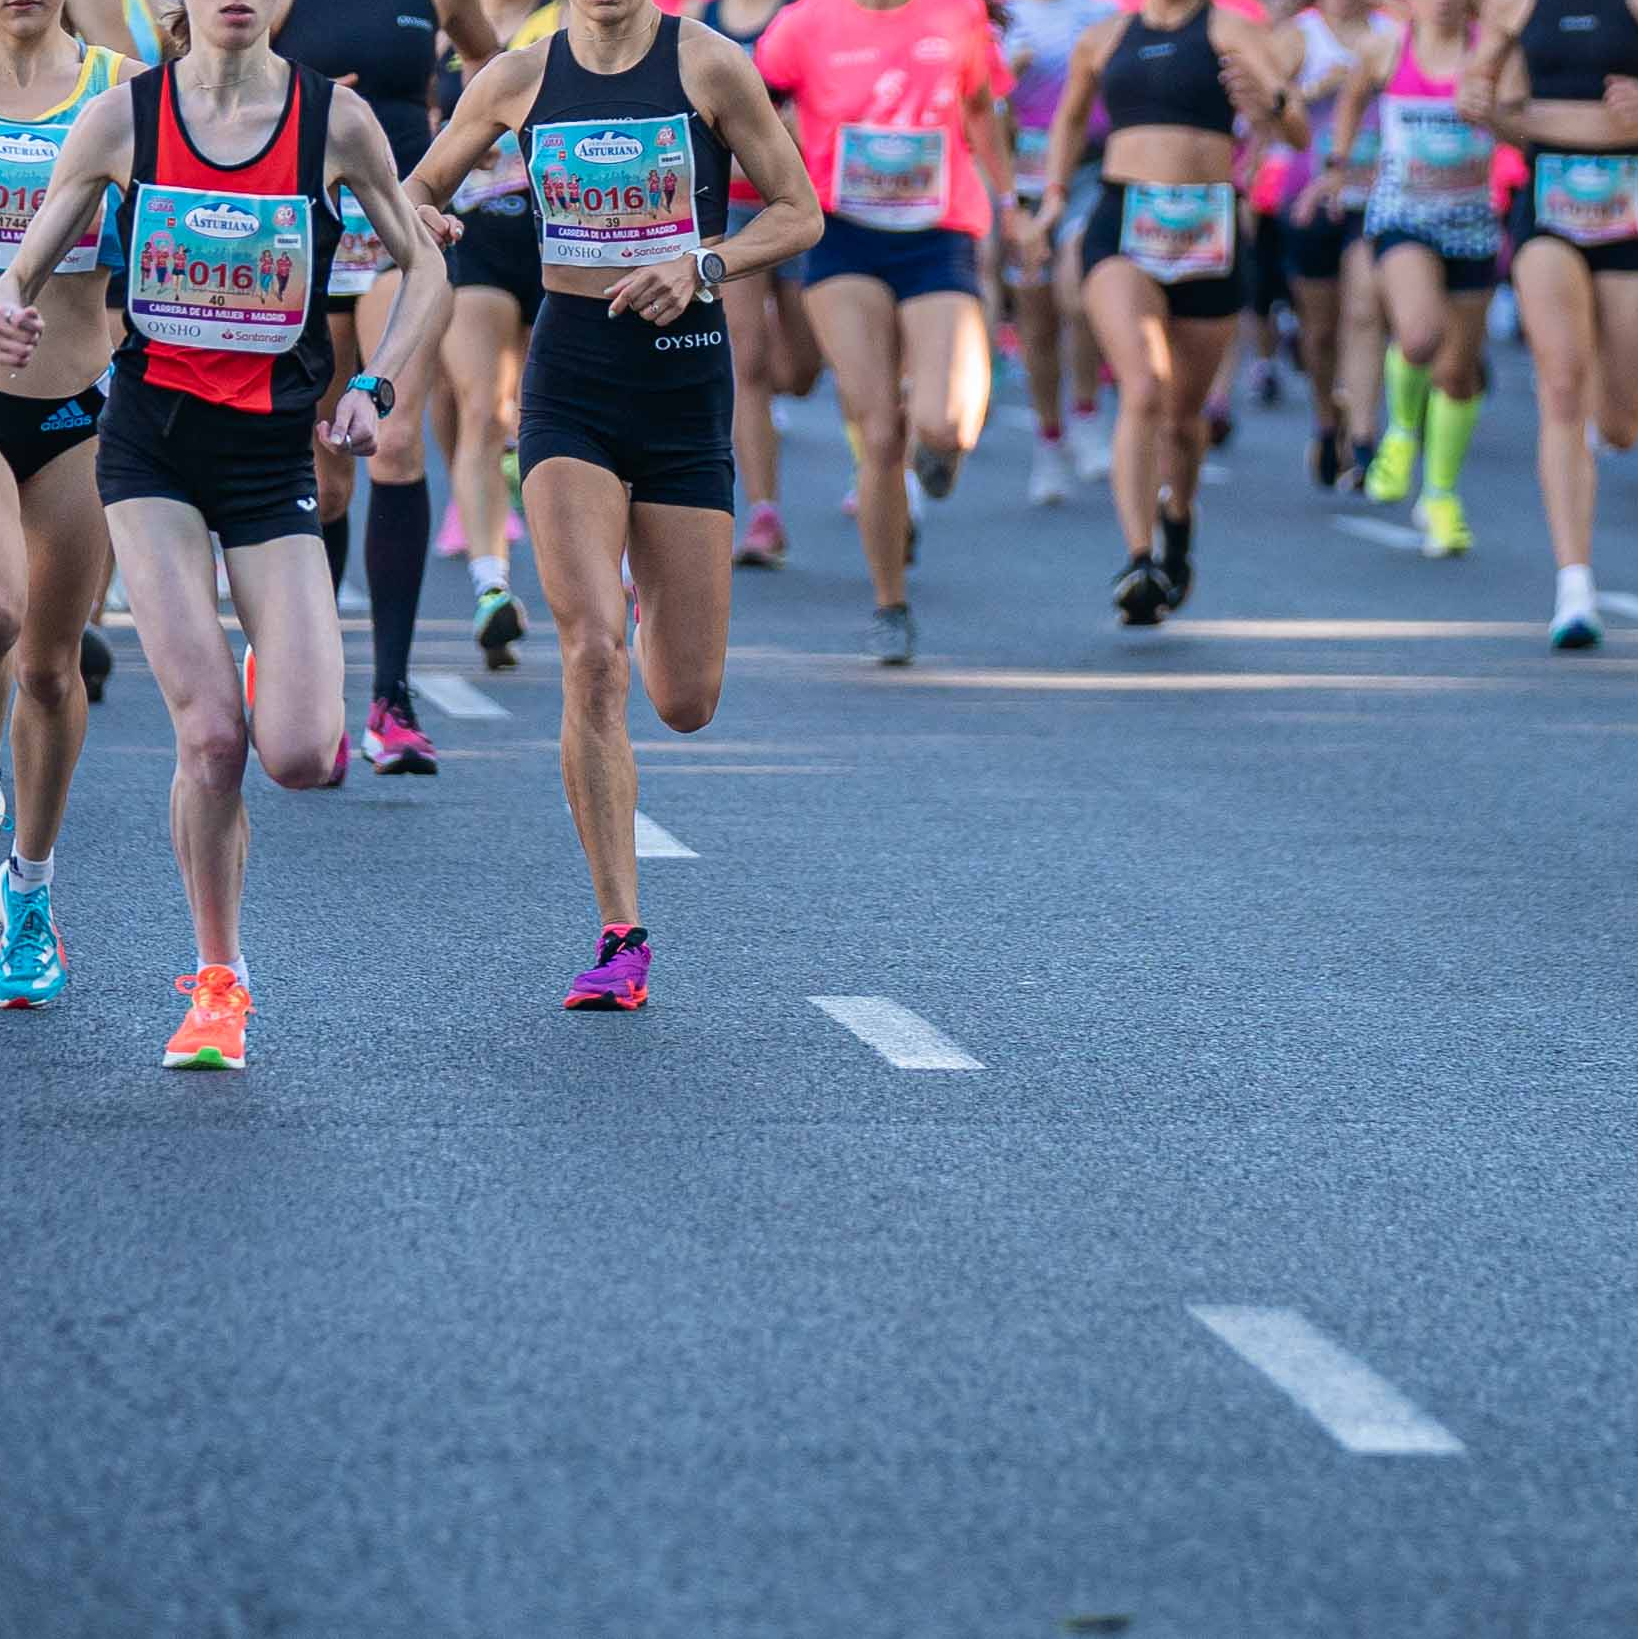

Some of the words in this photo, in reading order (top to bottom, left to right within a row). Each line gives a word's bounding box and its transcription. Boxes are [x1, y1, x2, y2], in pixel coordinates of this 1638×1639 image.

[579, 144, 640, 157] ASTURIANA
[583, 186, 644, 211] 016
[190, 214, 254, 231] ASTURIANA
[605, 217, 620, 227] 39
[2, 231, 12, 240] LA
[558, 227, 590, 239] CARRERA
[591, 230, 600, 239] DE
[601, 230, 611, 239] LA
[558, 245, 602, 259] OYSHO
[634, 244, 682, 258] Santander
[189, 261, 253, 290] 016
[209, 295, 225, 306] 40
[149, 303, 188, 315] CARRERA
[189, 307, 201, 316] DE
[202, 308, 212, 317] LA
[215, 310, 244, 321] MUJER
[251, 313, 287, 323] MADRID
[147, 321, 201, 338] OYSHO
[235, 331, 288, 344] Santander
[655, 330, 722, 351] OYSHO
[40, 413, 93, 432] adidas
